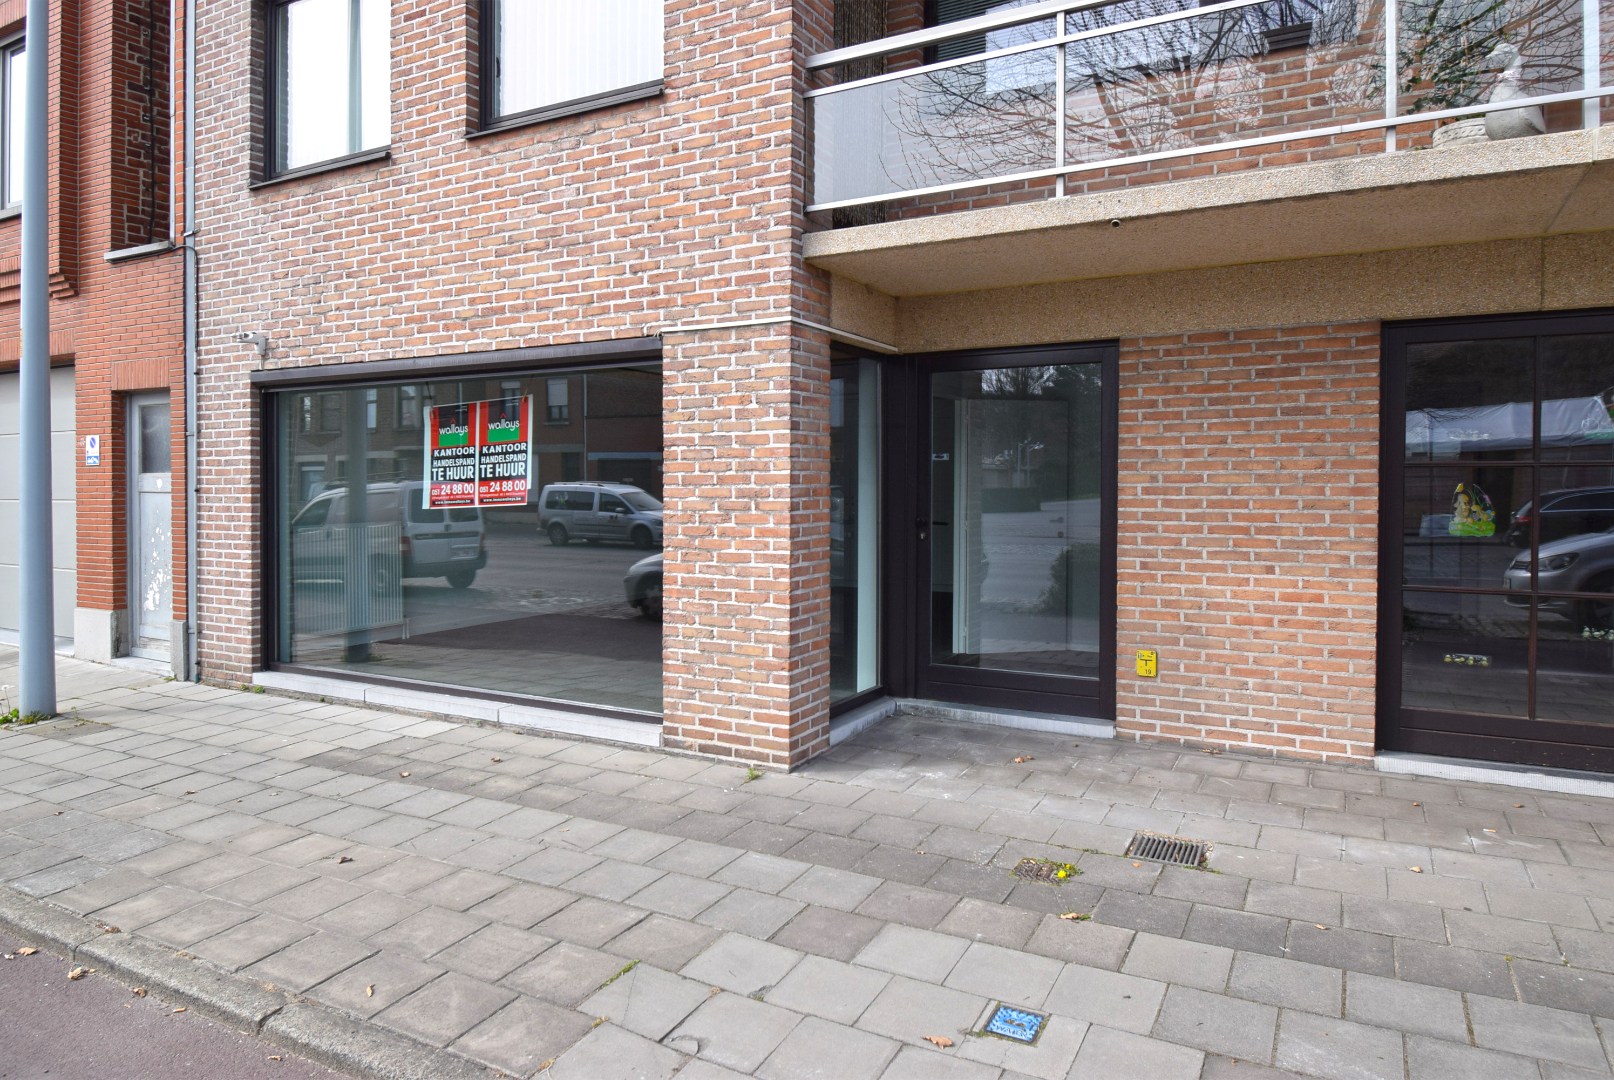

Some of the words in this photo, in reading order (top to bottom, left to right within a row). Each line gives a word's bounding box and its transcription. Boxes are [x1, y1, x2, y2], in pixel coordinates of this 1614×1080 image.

[439, 424, 468, 436] wallays
[488, 419, 520, 431] wallays
[434, 447, 474, 456] KANTOOR
[482, 443, 526, 454] KANTOOR
[433, 458, 474, 467] HANDELSPAND
[481, 453, 526, 464] HANDELSPAND
[432, 468, 444, 481] TE
[446, 466, 474, 480] HUUR
[480, 464, 494, 478] TE
[496, 462, 526, 477] HUUR
[441, 484, 451, 495] 24
[452, 484, 462, 494] 88
[464, 483, 474, 494] 00
[490, 482, 500, 492] 24
[502, 480, 512, 492] 88
[514, 480, 526, 490] 00
[996, 1025, 1027, 1038] WATER
